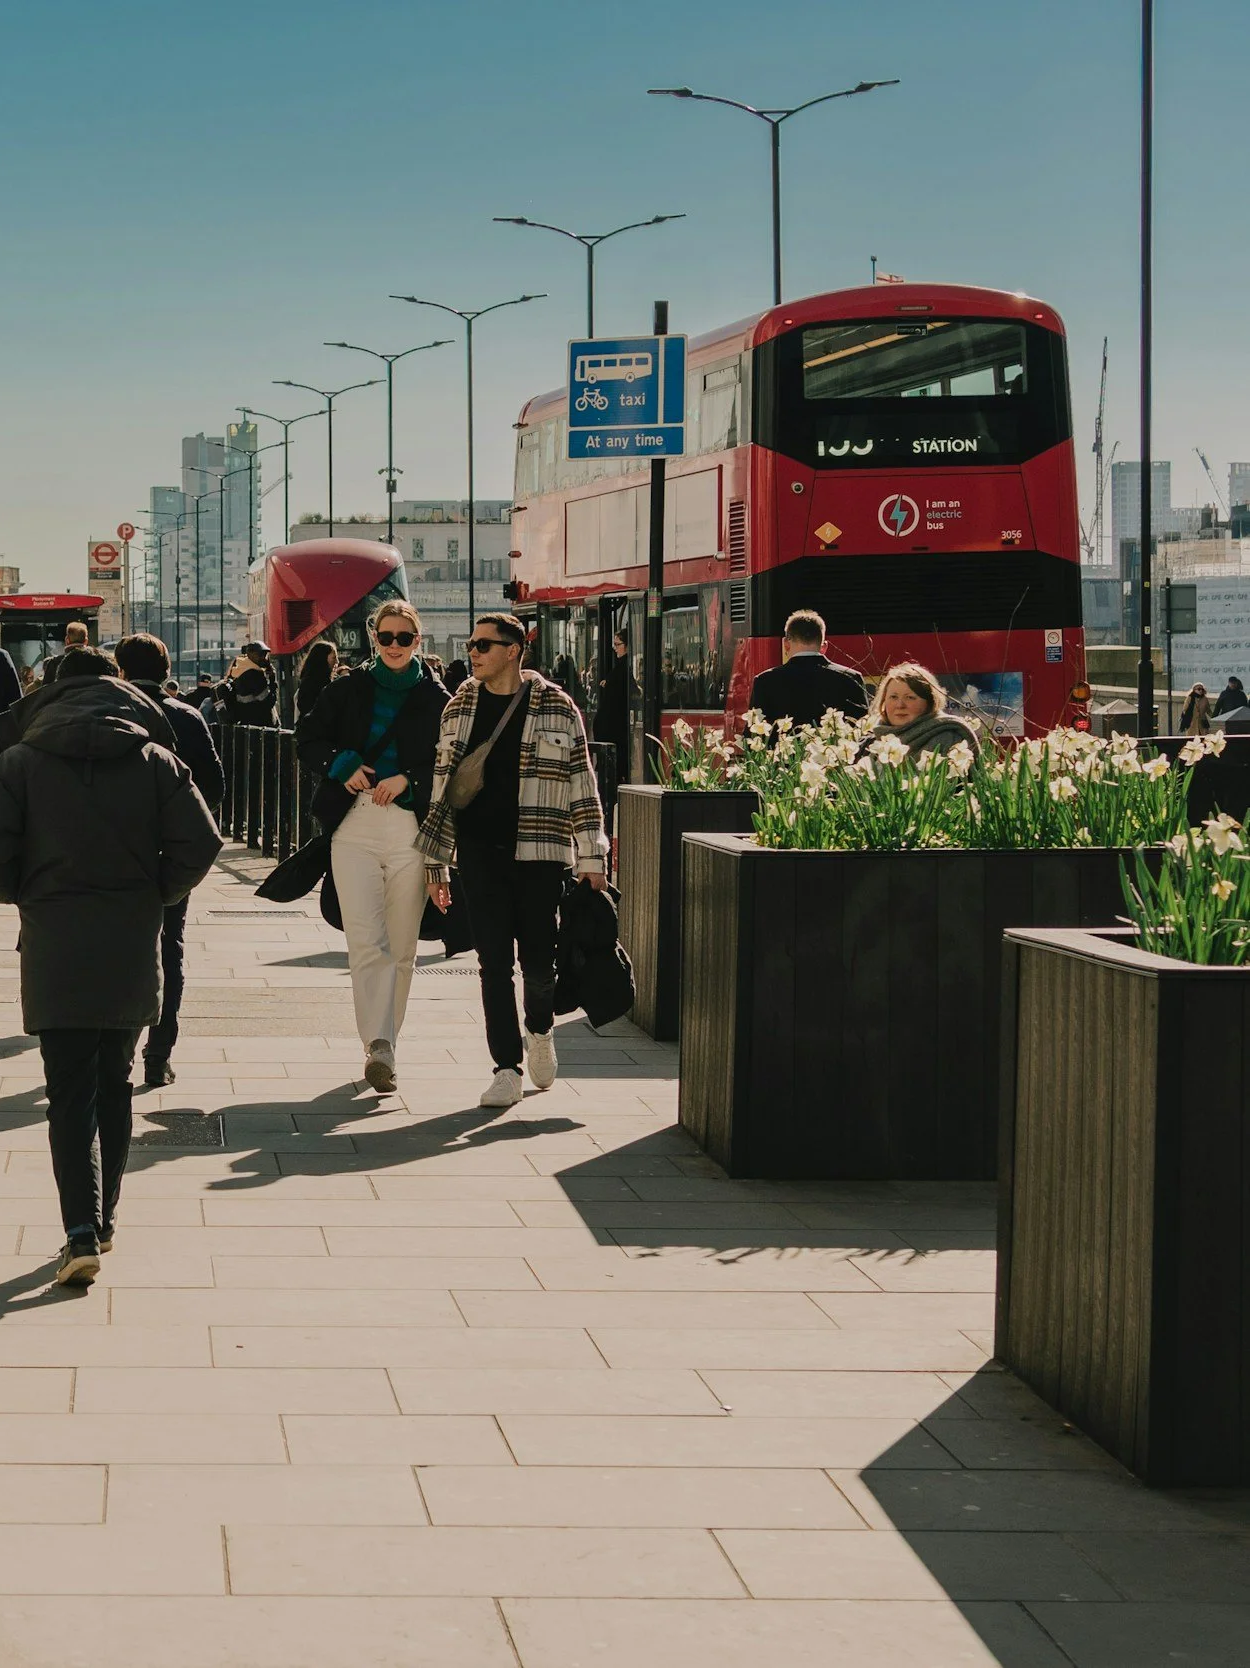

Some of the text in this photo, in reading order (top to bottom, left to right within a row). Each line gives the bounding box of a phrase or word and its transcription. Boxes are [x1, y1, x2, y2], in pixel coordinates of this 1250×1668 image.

[619, 392, 646, 406] taxi
[585, 433, 664, 450] At any time
[912, 438, 978, 454] STATION
[926, 499, 961, 509] I am an
[926, 509, 962, 519] electric
[926, 521, 944, 530] bus
[122, 525, 132, 539] P
[1001, 530, 1022, 540] 3056
